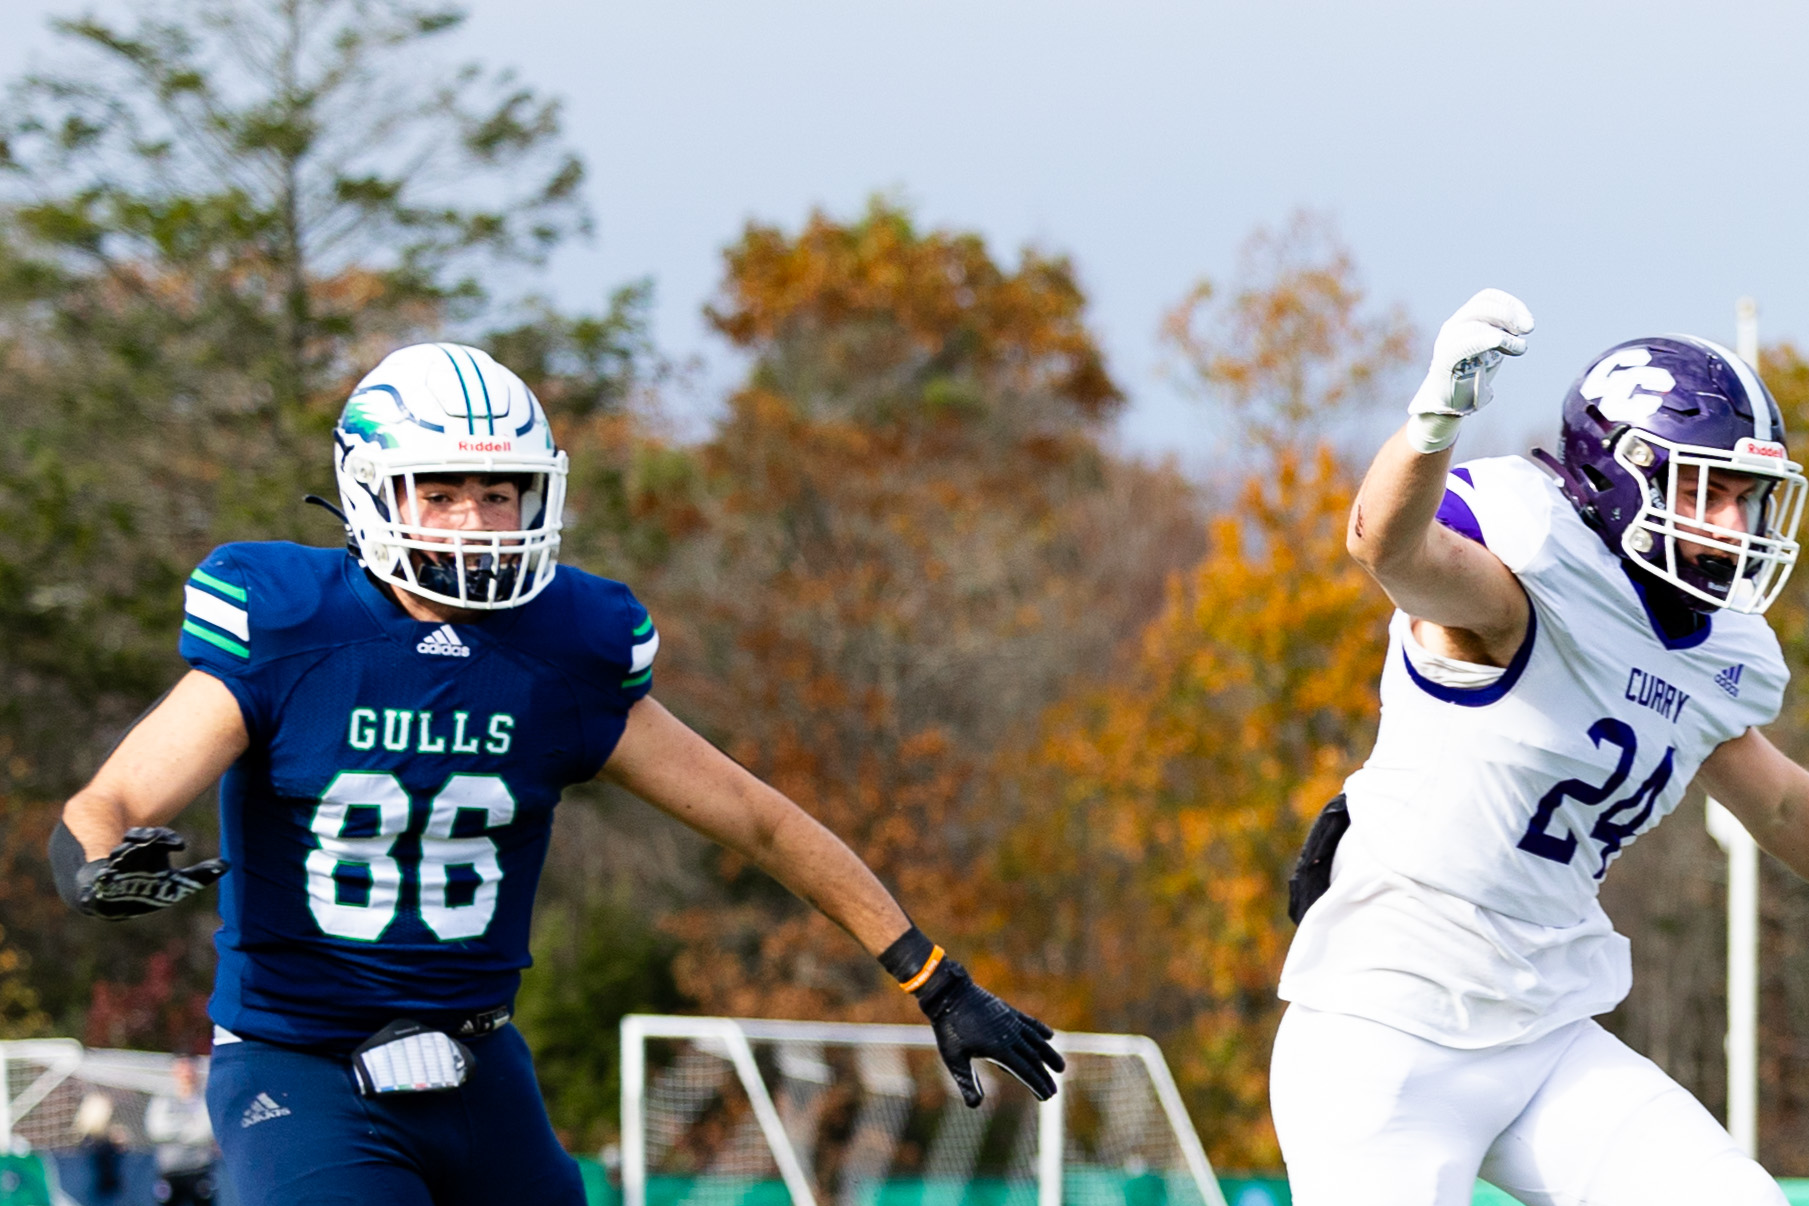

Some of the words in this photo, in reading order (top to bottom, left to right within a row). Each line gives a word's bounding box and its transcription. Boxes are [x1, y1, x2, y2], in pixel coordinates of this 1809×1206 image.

[458, 440, 512, 452] Riddell
[416, 642, 471, 657] adidas
[1625, 667, 1690, 724] CURRY
[348, 708, 514, 754] GULLS
[1516, 717, 1677, 880] 24
[305, 769, 515, 942] 86
